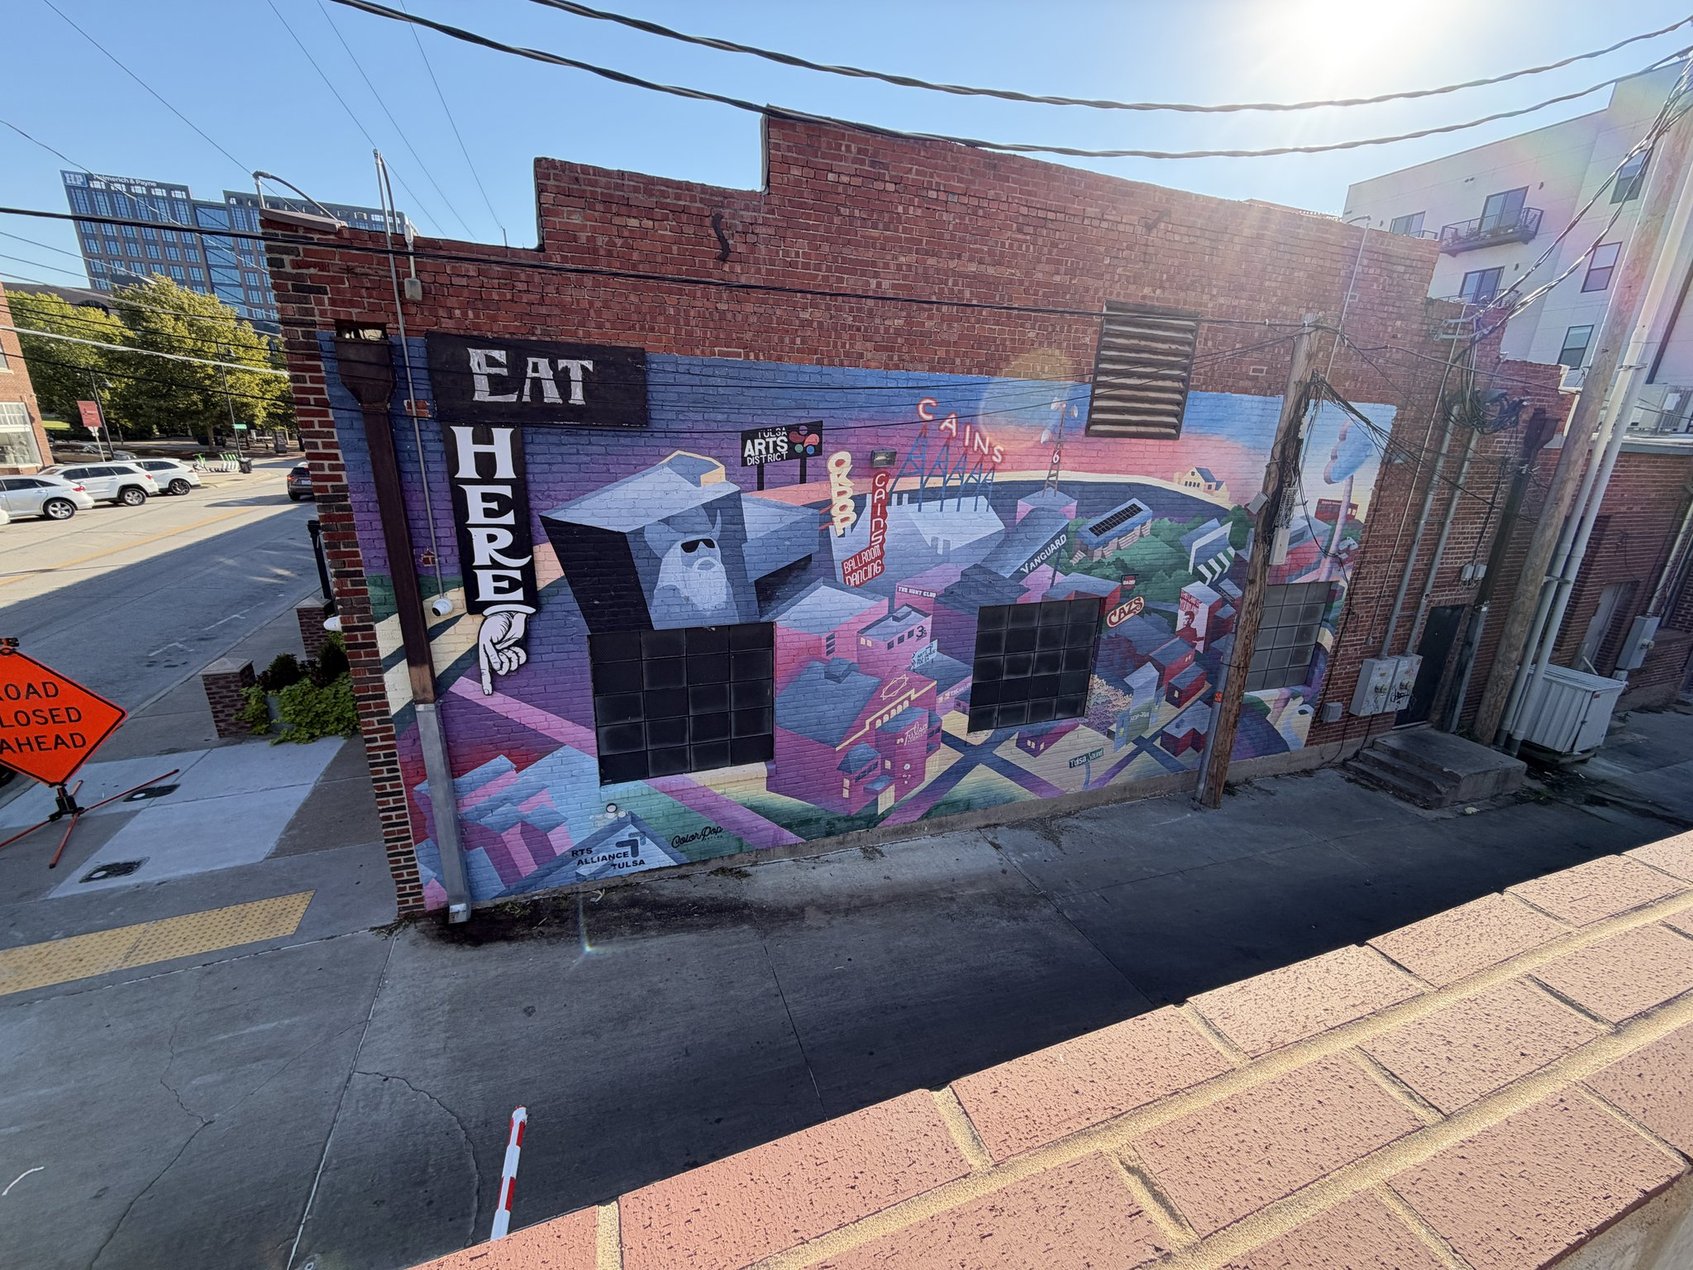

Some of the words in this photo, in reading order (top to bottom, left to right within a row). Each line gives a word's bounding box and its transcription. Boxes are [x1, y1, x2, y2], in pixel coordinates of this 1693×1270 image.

[63, 172, 84, 185] HP
[135, 179, 157, 187] Payne
[466, 347, 594, 406] EAT
[758, 426, 788, 439] TULSA
[917, 397, 1006, 464] CAINS
[743, 436, 788, 458] ARTS
[746, 450, 788, 466] DISTRICT
[1053, 449, 1060, 464] 6
[450, 425, 532, 602] HERE
[870, 473, 886, 546] CAINS
[843, 545, 882, 574] BALLROOM
[1020, 533, 1067, 575] VANGUARD
[845, 560, 882, 587] DANCING
[1108, 596, 1143, 626] CAZS
[0, 681, 60, 702] OAD
[0, 706, 82, 728] LOSED
[0, 732, 87, 755] AHEAD
[571, 847, 593, 858] RTS
[576, 851, 630, 867] ALLIANCE
[610, 859, 646, 870] TULSA
